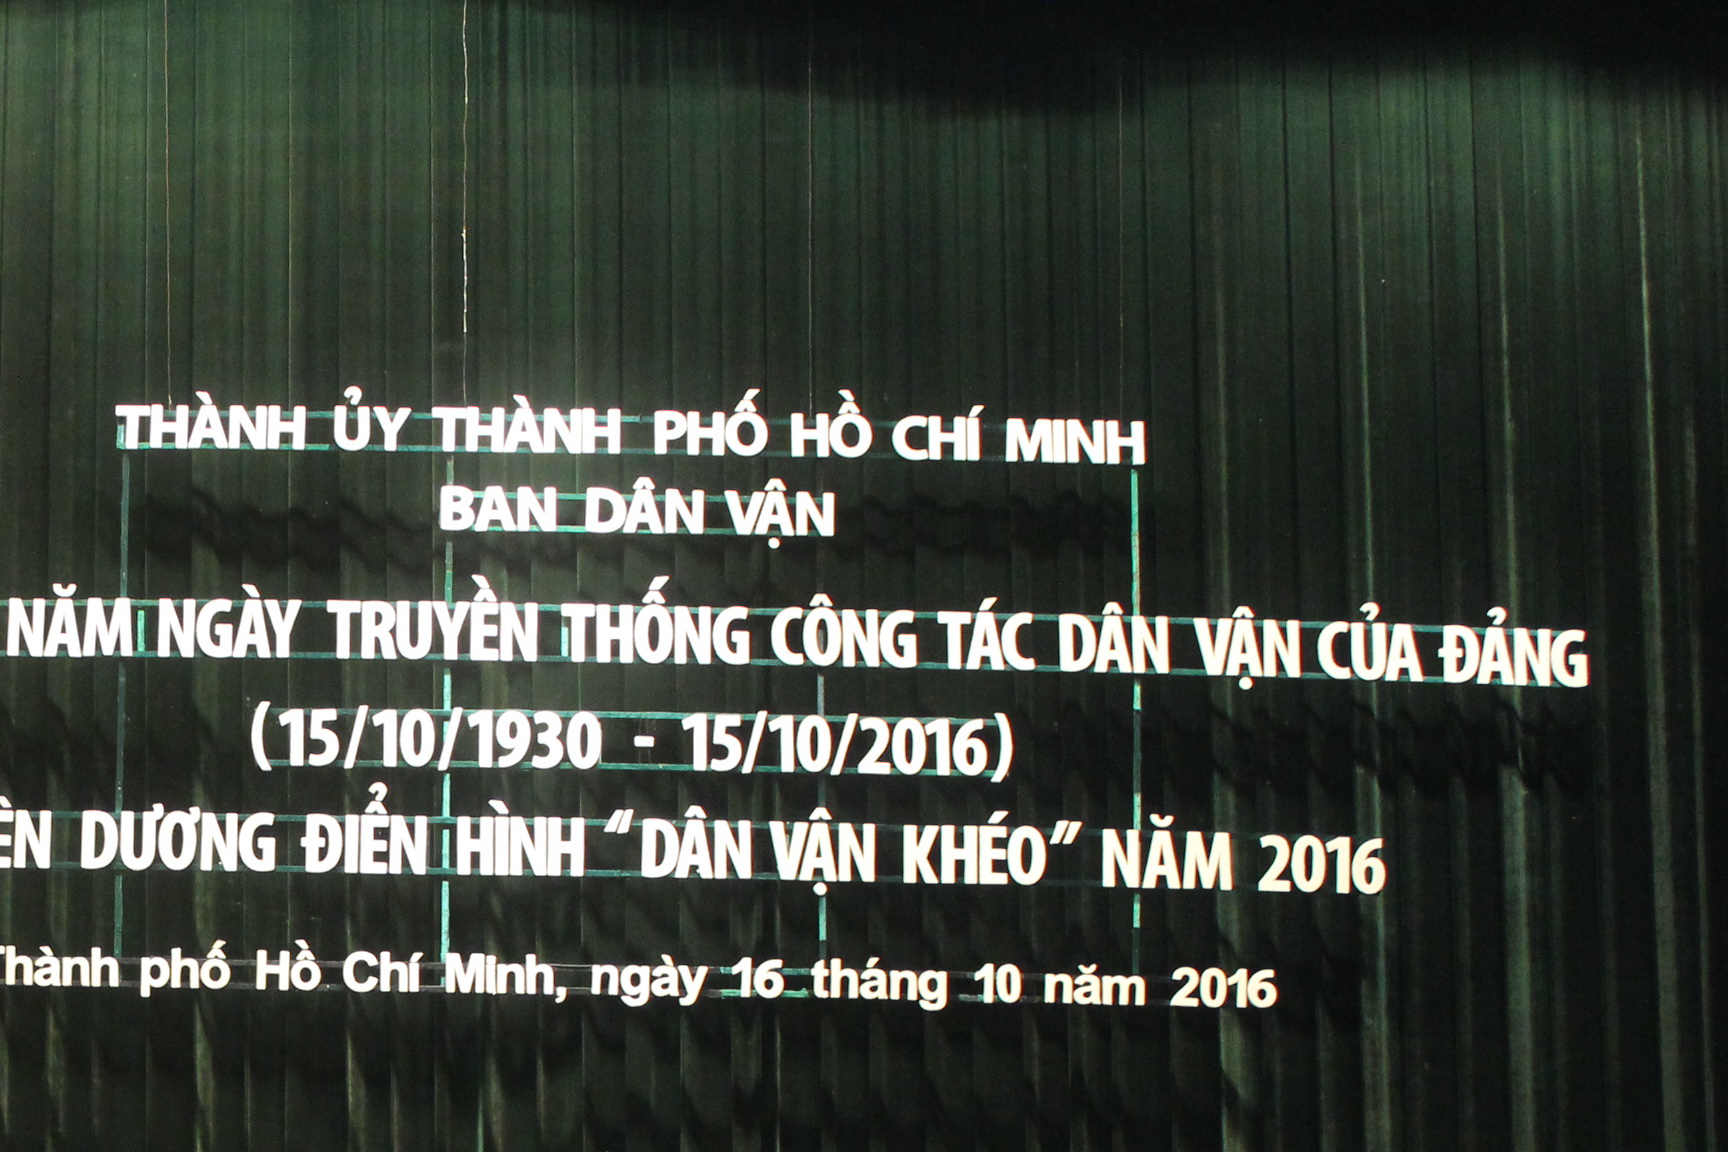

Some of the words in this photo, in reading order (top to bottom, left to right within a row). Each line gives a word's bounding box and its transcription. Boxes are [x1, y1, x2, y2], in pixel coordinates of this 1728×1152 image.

[115, 391, 307, 451] THÀNH
[333, 385, 412, 452] ỦY
[431, 394, 622, 455] THÀNH
[653, 388, 768, 457] PHỐ
[790, 389, 873, 458] HỒ
[892, 405, 984, 461] CHÍ
[1005, 418, 1145, 465] MINH
[439, 481, 561, 532] BAN
[582, 476, 705, 535] DÂN
[723, 478, 835, 549] VẬN
[6, 583, 134, 658] NĂM
[157, 583, 303, 659] NGÀY
[326, 574, 541, 662] TRUYỀN
[559, 575, 750, 665] THỐNG
[771, 594, 917, 669] CÔNG
[937, 597, 1036, 671] TÁC
[1058, 602, 1169, 674] DÂN
[1192, 606, 1301, 690] VẬN
[1317, 602, 1424, 682] CỦA
[1438, 606, 1588, 688] ĐẢNG
[251, 700, 603, 771] (15/10/1930
[681, 710, 1013, 783] 15/10/2016)
[80, 803, 276, 872] DƯƠNG
[300, 781, 429, 876] ĐIỂN
[456, 799, 586, 877] HÌNH
[768, 807, 876, 896] VẬN
[1102, 814, 1232, 891] NĂM
[1258, 834, 1385, 895] 2016
[140, 939, 231, 998] phố
[255, 939, 322, 991] Hồ
[342, 950, 424, 993] Chí
[441, 950, 567, 1004] Minh,
[590, 954, 709, 1007] ngày
[731, 956, 784, 999] 16
[810, 957, 947, 1011] tháng
[974, 963, 1021, 1004] 10
[1044, 963, 1145, 1006] năm
[1170, 966, 1277, 1008] 2016
